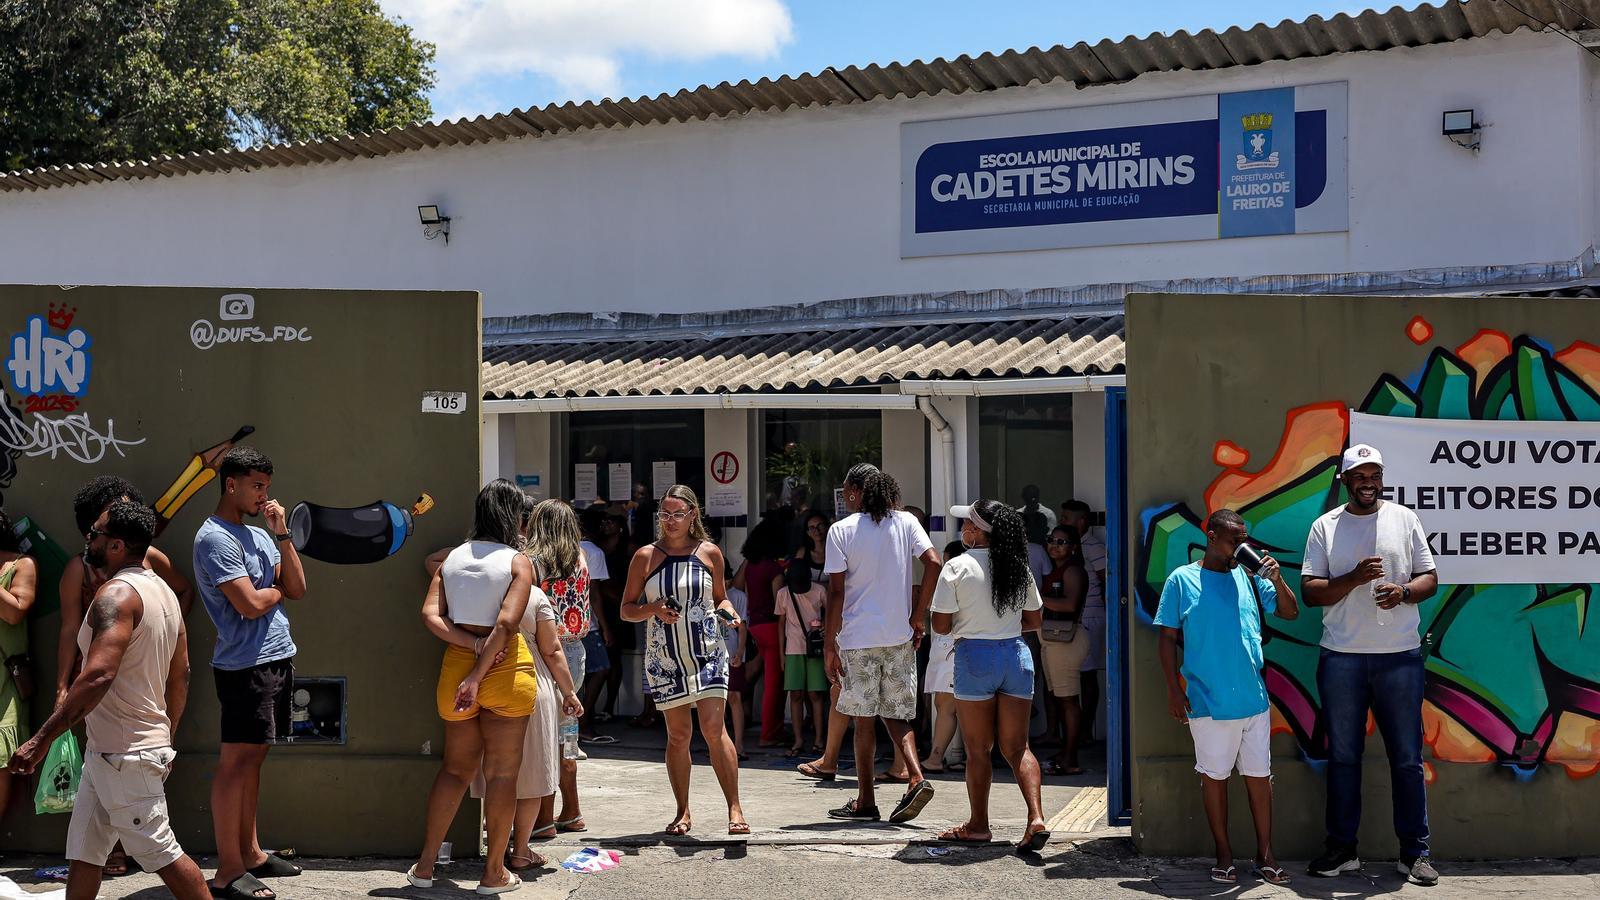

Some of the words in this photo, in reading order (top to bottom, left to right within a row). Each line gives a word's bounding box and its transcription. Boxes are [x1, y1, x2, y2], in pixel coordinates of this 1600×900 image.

[980, 150, 1038, 168] ESCOLA
[1037, 145, 1121, 164] MUNICIPAL
[1121, 142, 1141, 157] DE
[931, 165, 1071, 202] CADETES
[1077, 155, 1195, 192] MIRINS
[1231, 172, 1275, 182] PREFEITURA
[1275, 172, 1285, 180] DE
[1227, 183, 1271, 197] LAURO
[1272, 181, 1290, 194] DE
[983, 202, 1032, 214] SECRETARIA
[1034, 198, 1079, 211] MUNICIPAL
[1082, 197, 1093, 208] DE
[1096, 193, 1140, 207] EDUCAÇÃO
[1233, 196, 1284, 210] FREITAS
[190, 319, 312, 350] @DUFS_FDC
[433, 397, 458, 409] 105
[1430, 440, 1516, 469] AQUI
[1526, 440, 1600, 464] VOT
[1568, 486, 1600, 510] D
